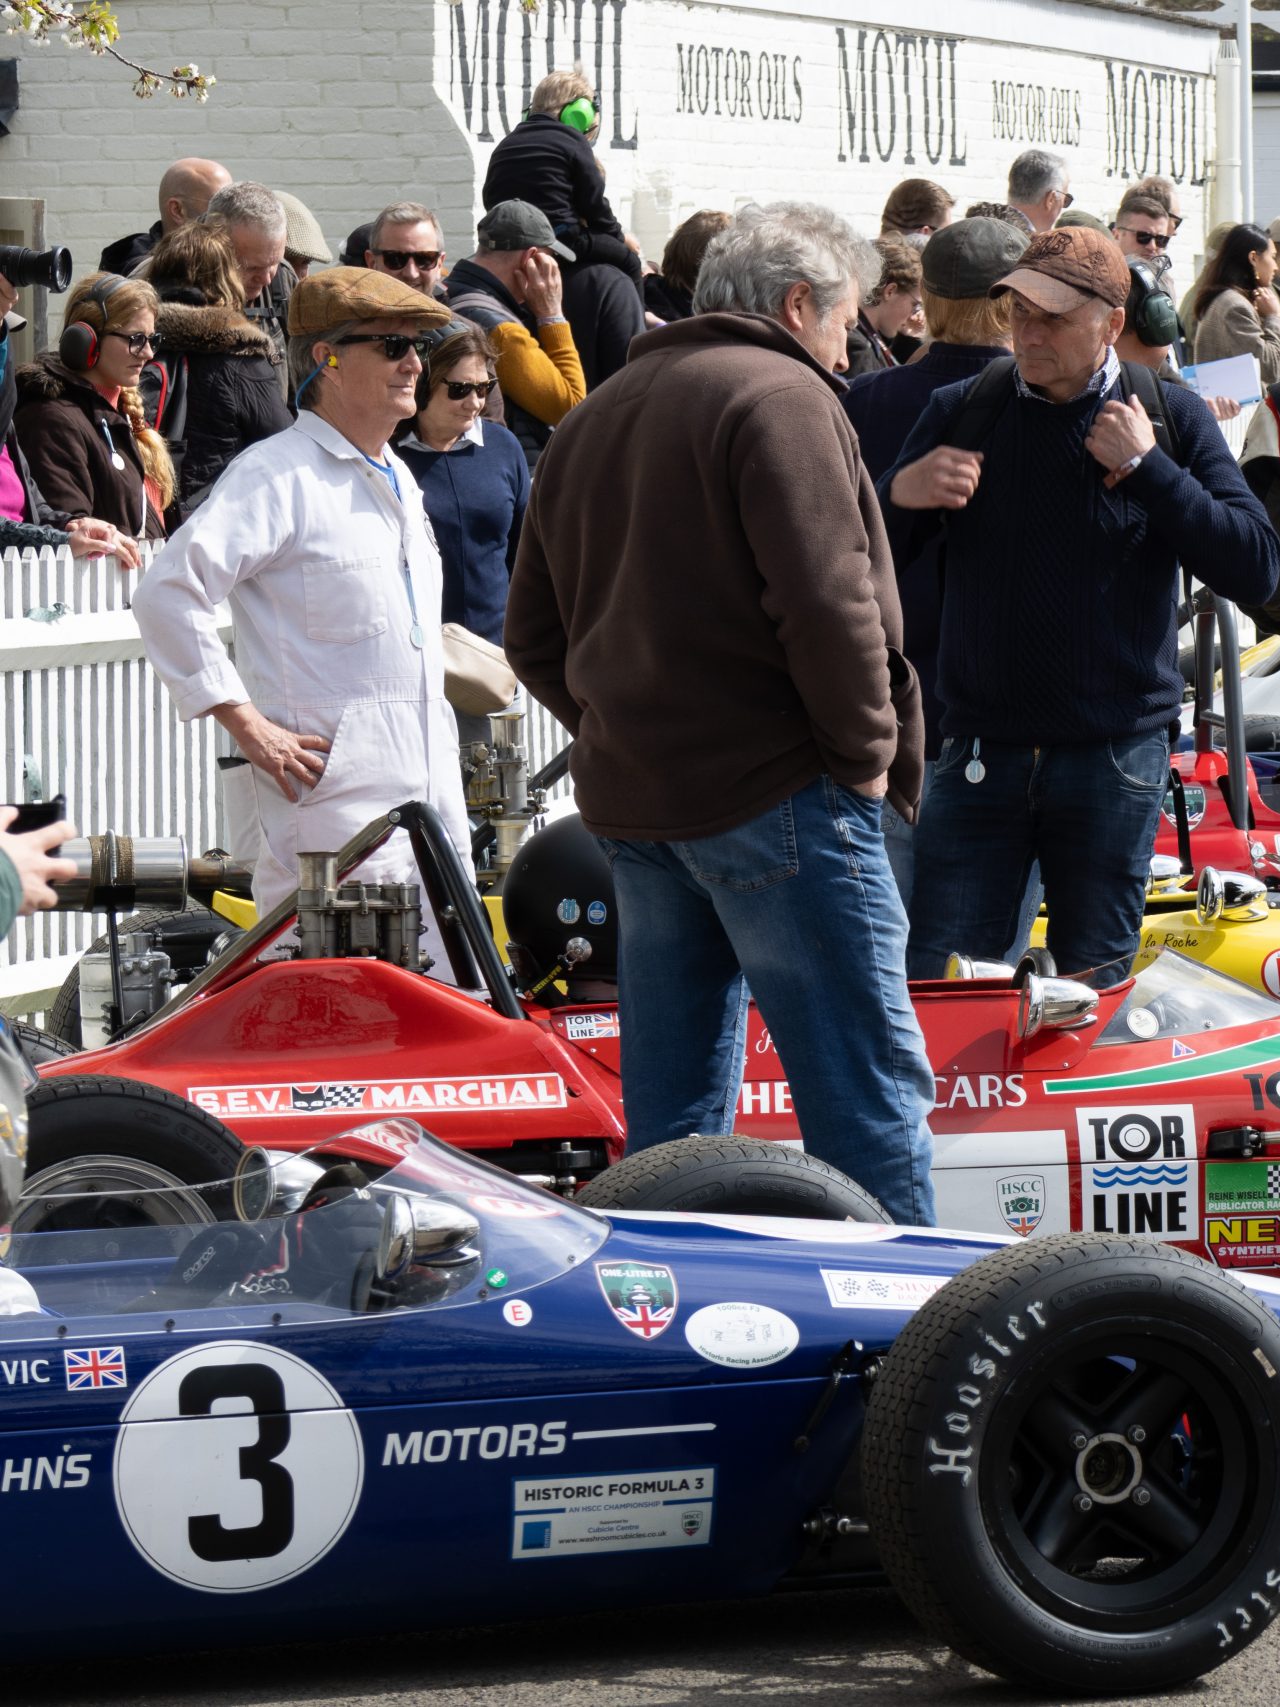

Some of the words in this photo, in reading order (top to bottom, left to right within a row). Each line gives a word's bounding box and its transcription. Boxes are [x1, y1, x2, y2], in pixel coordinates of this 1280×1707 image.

[676, 43, 753, 117] MOTOR
[757, 51, 802, 123] OILS
[835, 27, 967, 166] MOTUL
[992, 80, 1047, 142] MOTOR
[1050, 87, 1081, 147] OILS
[1105, 61, 1206, 187] MOTUL
[1163, 933, 1199, 948] Roche
[567, 1015, 593, 1025] TOR
[570, 1028, 595, 1038] LINE
[196, 1088, 286, 1113] S.E.V.
[371, 1080, 558, 1108] MARCHAL
[1088, 1113, 1186, 1161] TOR
[1001, 1181, 1041, 1195] HSCC
[1209, 1191, 1234, 1201] REINE
[1237, 1191, 1267, 1200] WISELL
[1093, 1191, 1187, 1234] LINE
[1209, 1201, 1264, 1210] PUBLICATOR
[601, 1268, 654, 1278] ONE-LITRE
[655, 1270, 668, 1278] F3
[511, 1305, 525, 1321] E
[699, 1345, 725, 1362] Historic
[726, 1356, 750, 1366] Racing
[752, 1346, 790, 1364] Association
[929, 1299, 1047, 1488] Hoosier
[382, 1421, 567, 1466] MOTORS
[178, 1362, 296, 1563] 3
[524, 1485, 604, 1502] HISTORIC
[608, 1479, 690, 1497] FORMULA
[695, 1478, 704, 1490] 3
[582, 1504, 603, 1512] HSCC
[604, 1501, 661, 1511] CHAMPIONSHIP
[587, 1525, 614, 1533] Cubicle
